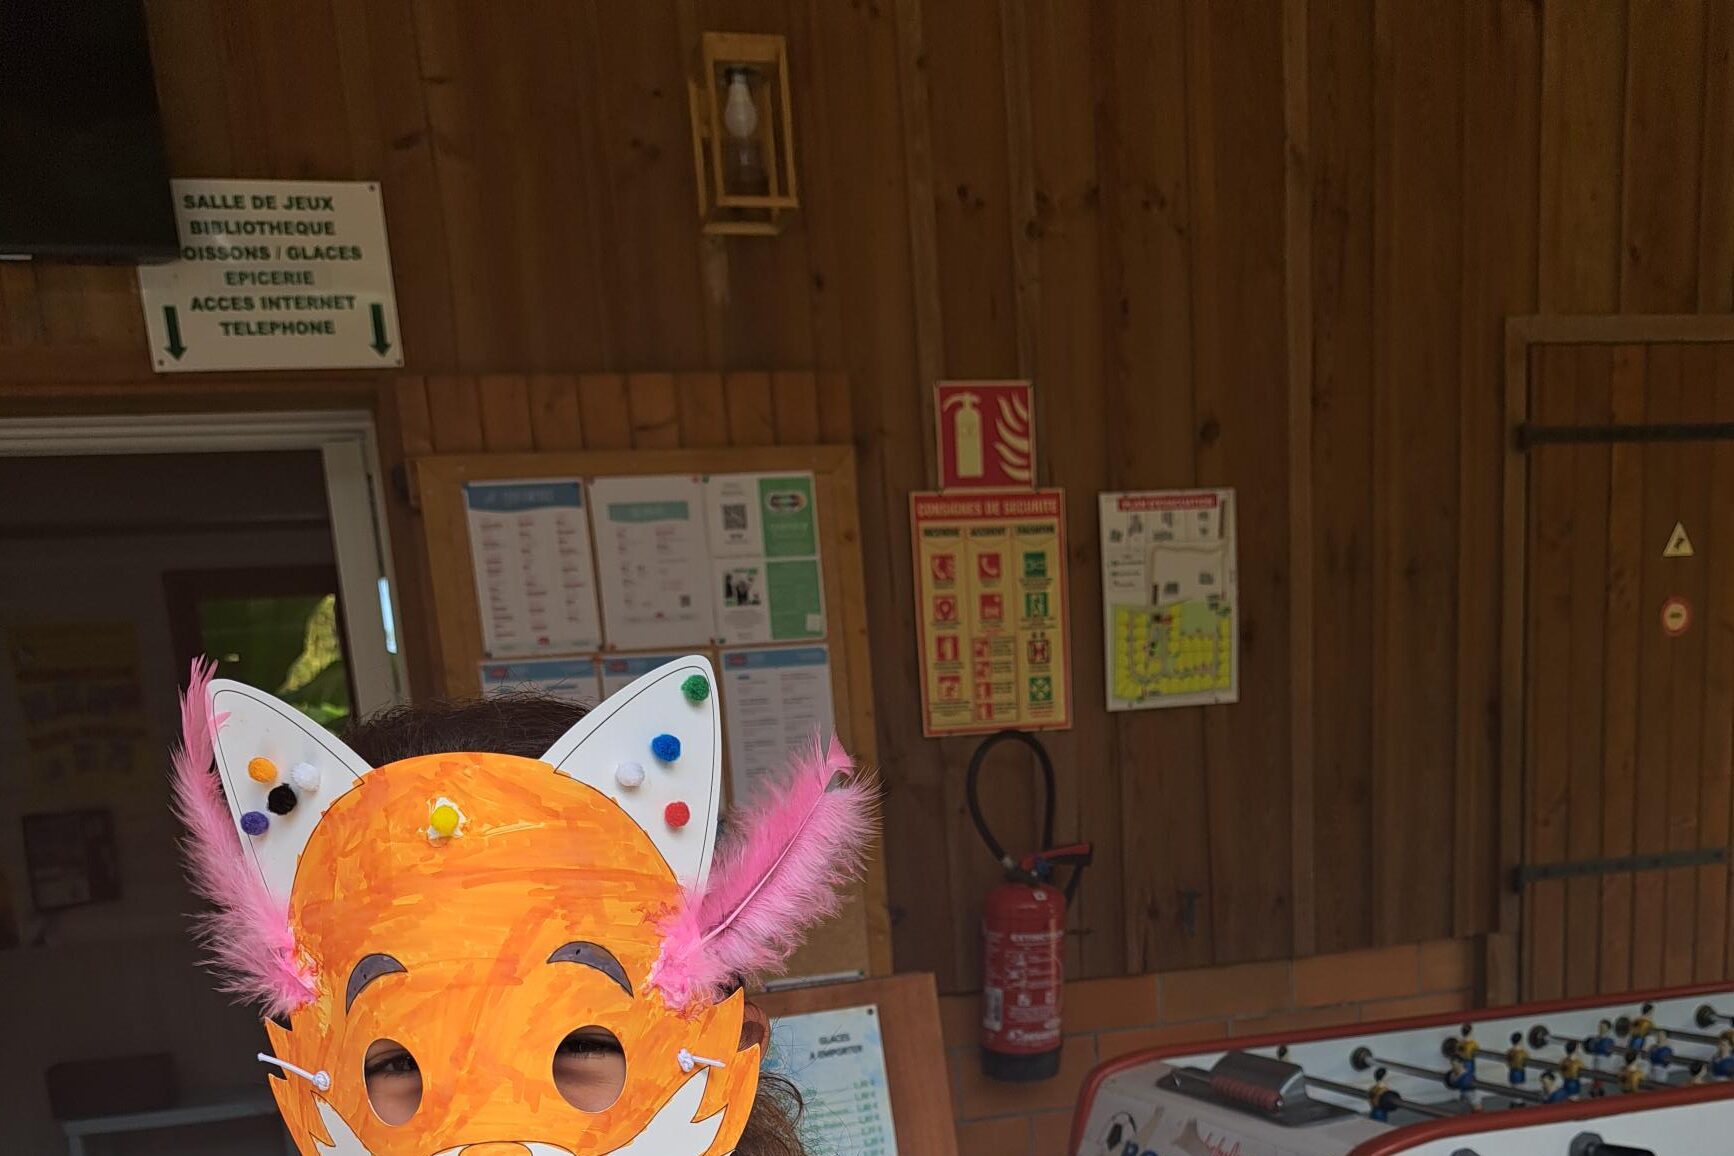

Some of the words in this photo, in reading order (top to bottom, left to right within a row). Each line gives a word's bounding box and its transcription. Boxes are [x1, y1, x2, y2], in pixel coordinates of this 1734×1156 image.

[183, 195, 246, 210] SALLE
[252, 195, 277, 210] DE
[283, 196, 335, 211] JEUX
[190, 220, 336, 235] BIBLIOTHEQUE
[177, 246, 271, 261] OISSONS
[286, 246, 363, 260] GLACES
[224, 271, 315, 285] EPICERIE
[190, 296, 256, 311] ACCES
[261, 296, 357, 310] INTERNET
[219, 321, 336, 336] TELEPHONE
